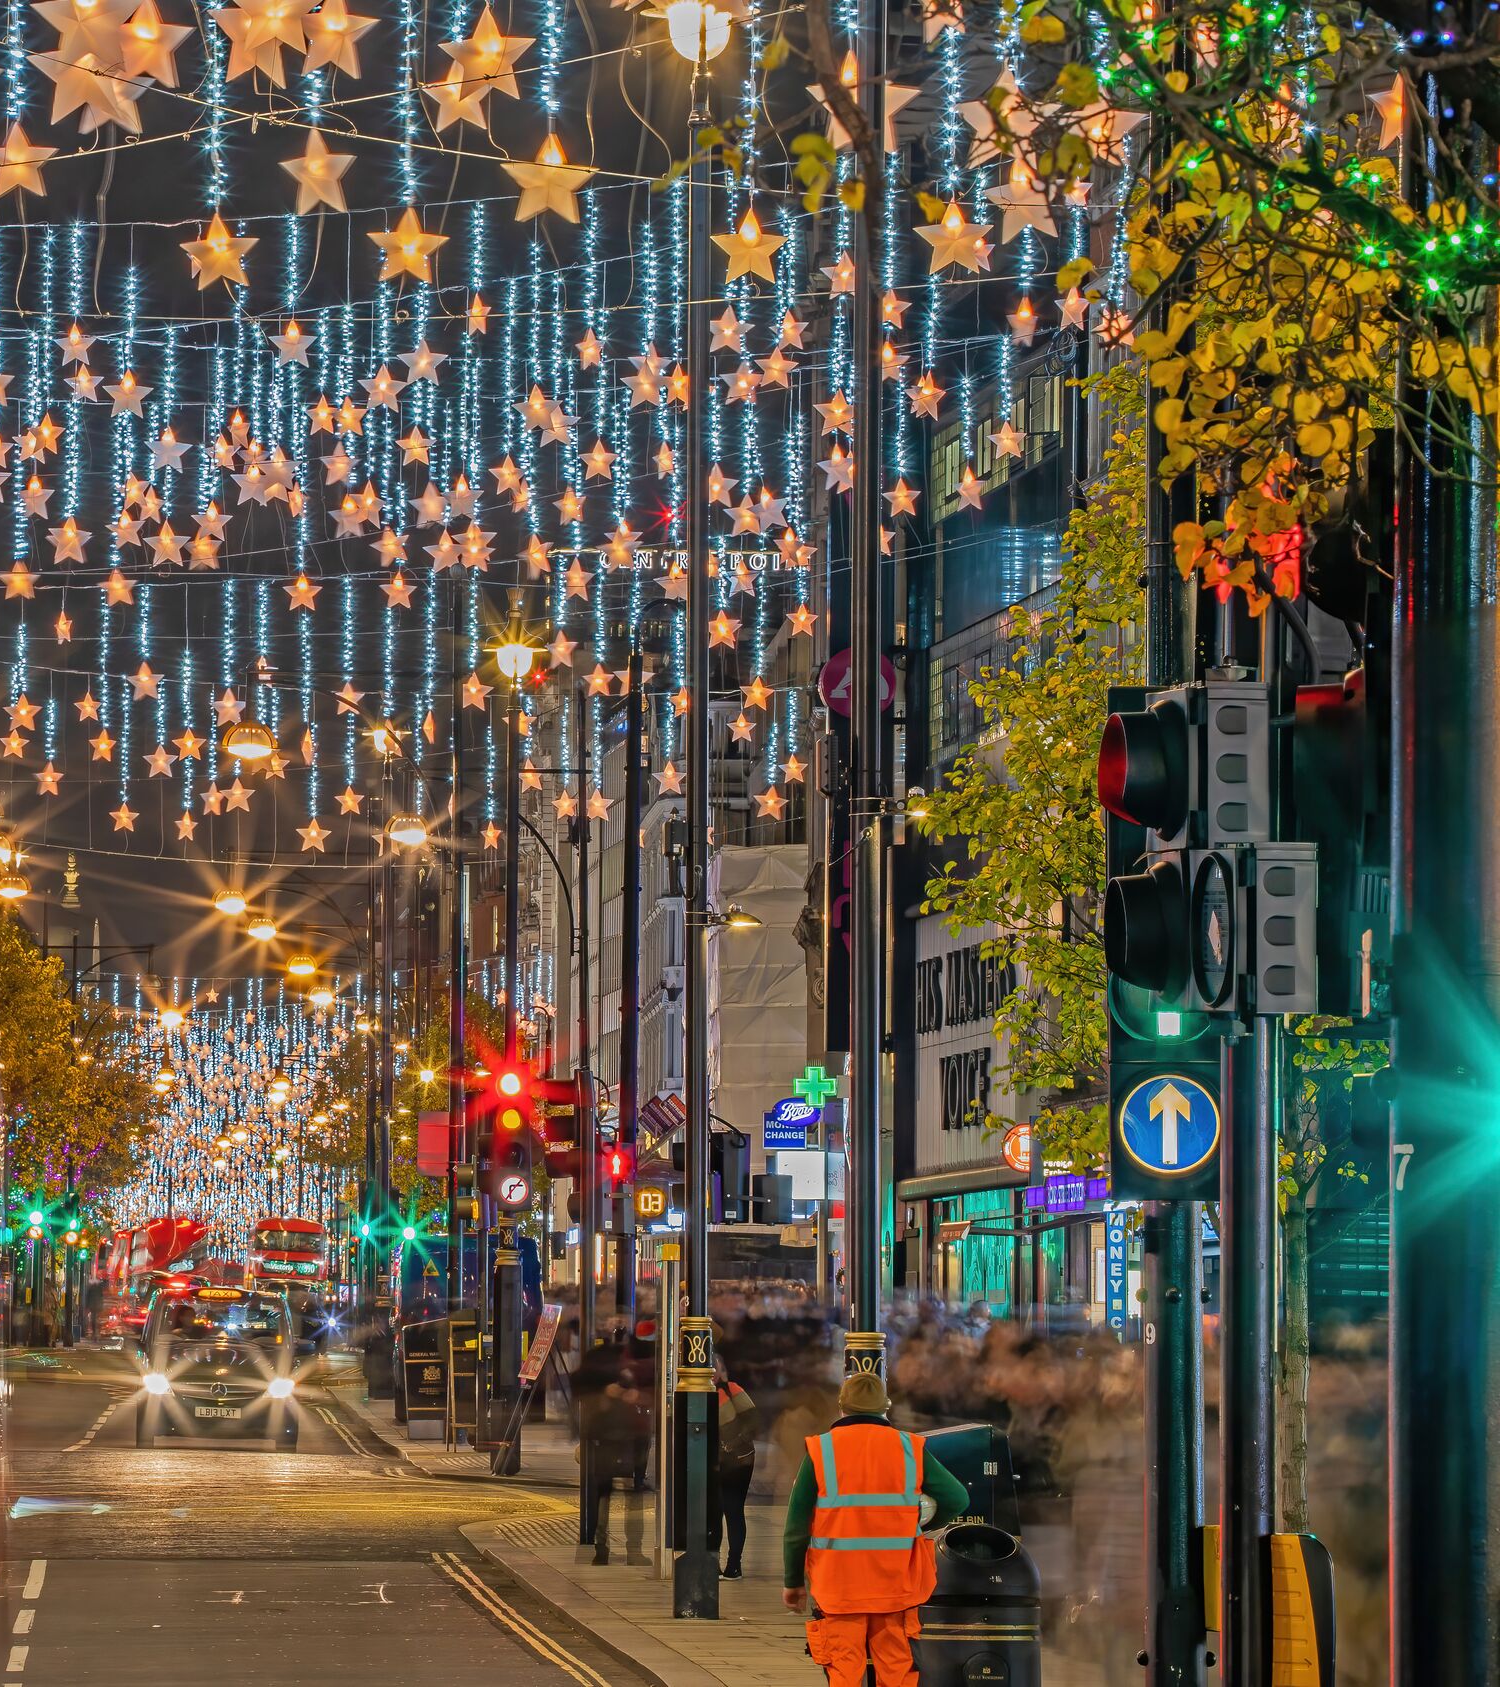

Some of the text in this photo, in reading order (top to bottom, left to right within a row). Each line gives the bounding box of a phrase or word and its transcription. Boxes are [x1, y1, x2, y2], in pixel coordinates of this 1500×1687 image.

[916, 956, 943, 1035] HIS
[939, 1047, 992, 1131] VOICE
[765, 1131, 805, 1140] CHANGE
[1393, 1144, 1414, 1191] 7
[641, 1193, 662, 1212] 03
[1109, 1212, 1124, 1293] MONEY
[1145, 1322, 1156, 1345] 9
[220, 1409, 237, 1417] LXT
[966, 1515, 985, 1525] BIN
